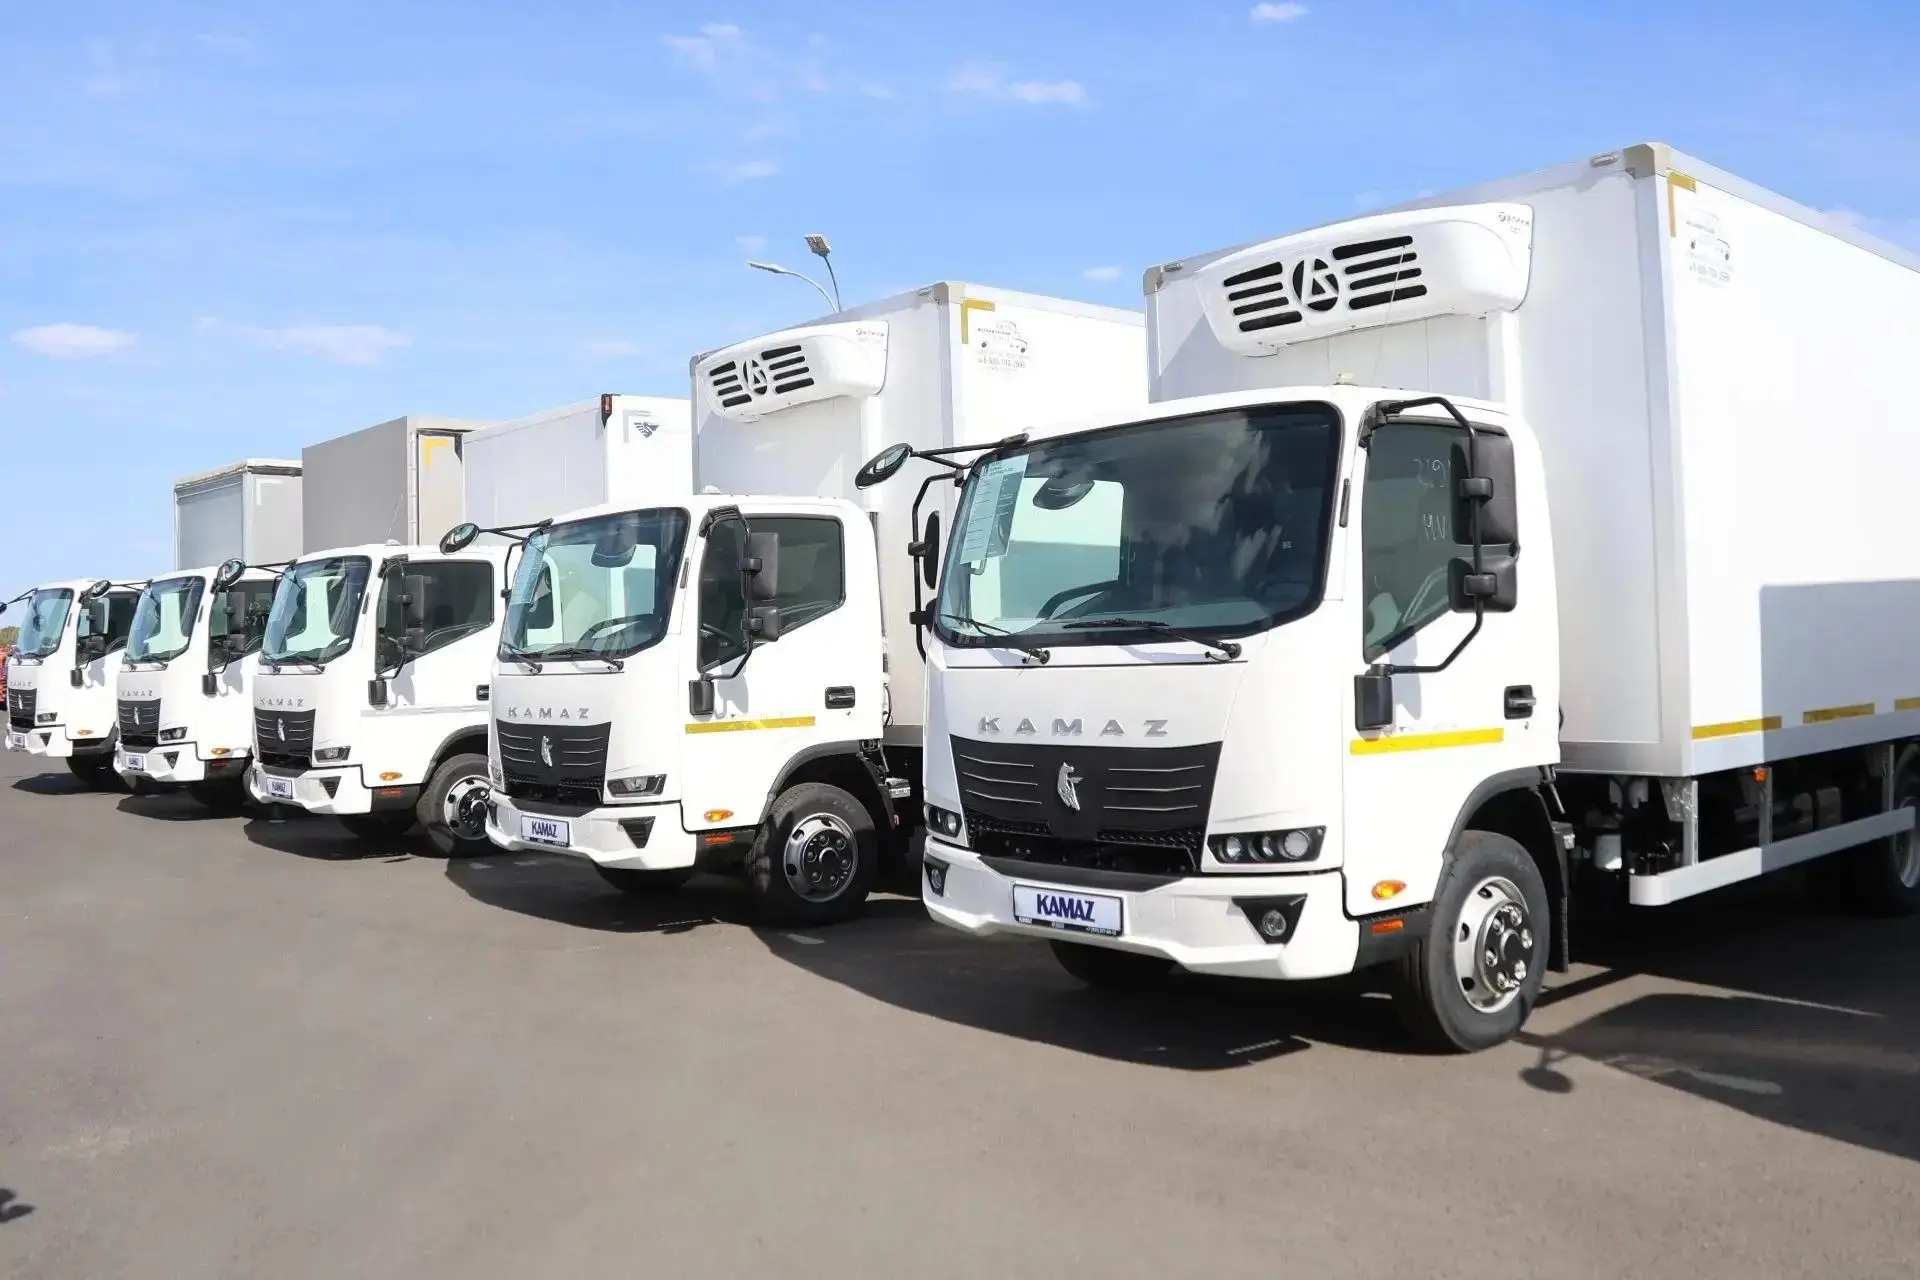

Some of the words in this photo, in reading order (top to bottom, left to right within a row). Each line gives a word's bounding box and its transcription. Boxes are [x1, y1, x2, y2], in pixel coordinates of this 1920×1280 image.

[259, 697, 304, 707] KAMAZ
[508, 706, 590, 720] KAMAZ
[978, 716, 1169, 738] KAMAZ
[532, 821, 558, 838] KAMAZ
[1037, 893, 1096, 922] KAMAZ
